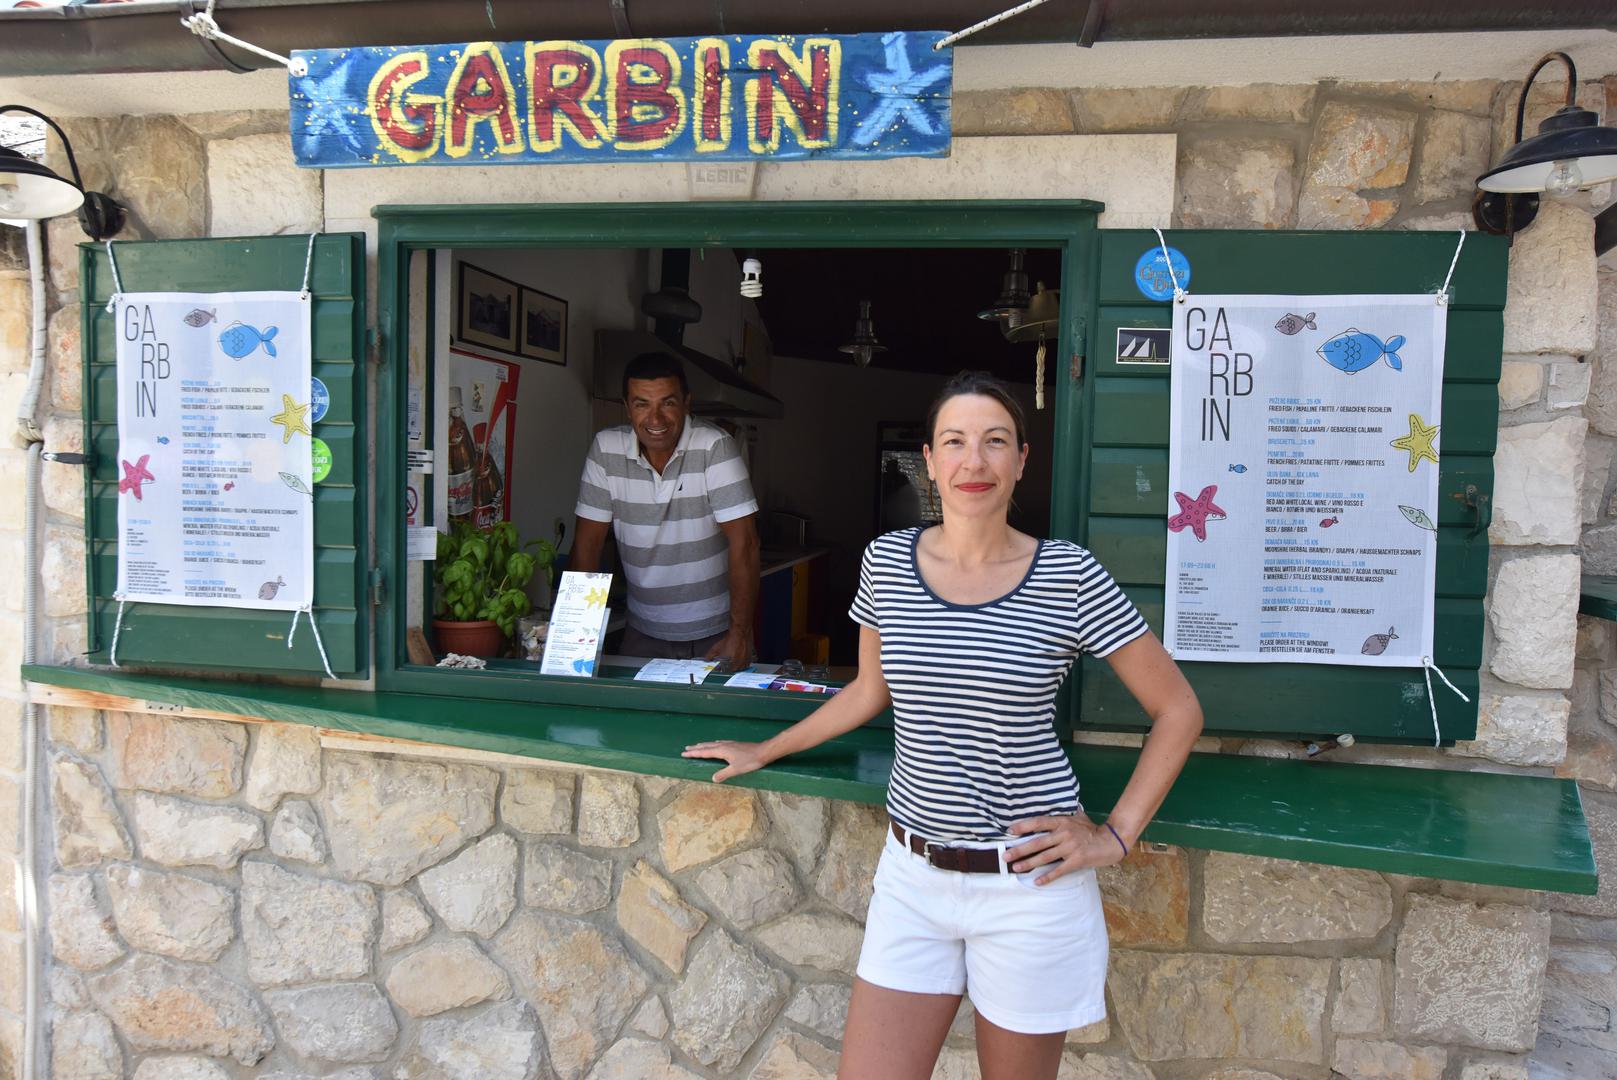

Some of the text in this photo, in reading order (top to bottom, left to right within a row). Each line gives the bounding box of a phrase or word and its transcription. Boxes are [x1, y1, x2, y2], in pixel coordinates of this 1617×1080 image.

[368, 39, 842, 163] GARBIN
[124, 304, 156, 341] GA
[1186, 307, 1233, 351] GA
[141, 343, 170, 380] RB
[1210, 353, 1253, 396] RB
[136, 381, 156, 417] IN
[1202, 398, 1230, 441] IN
